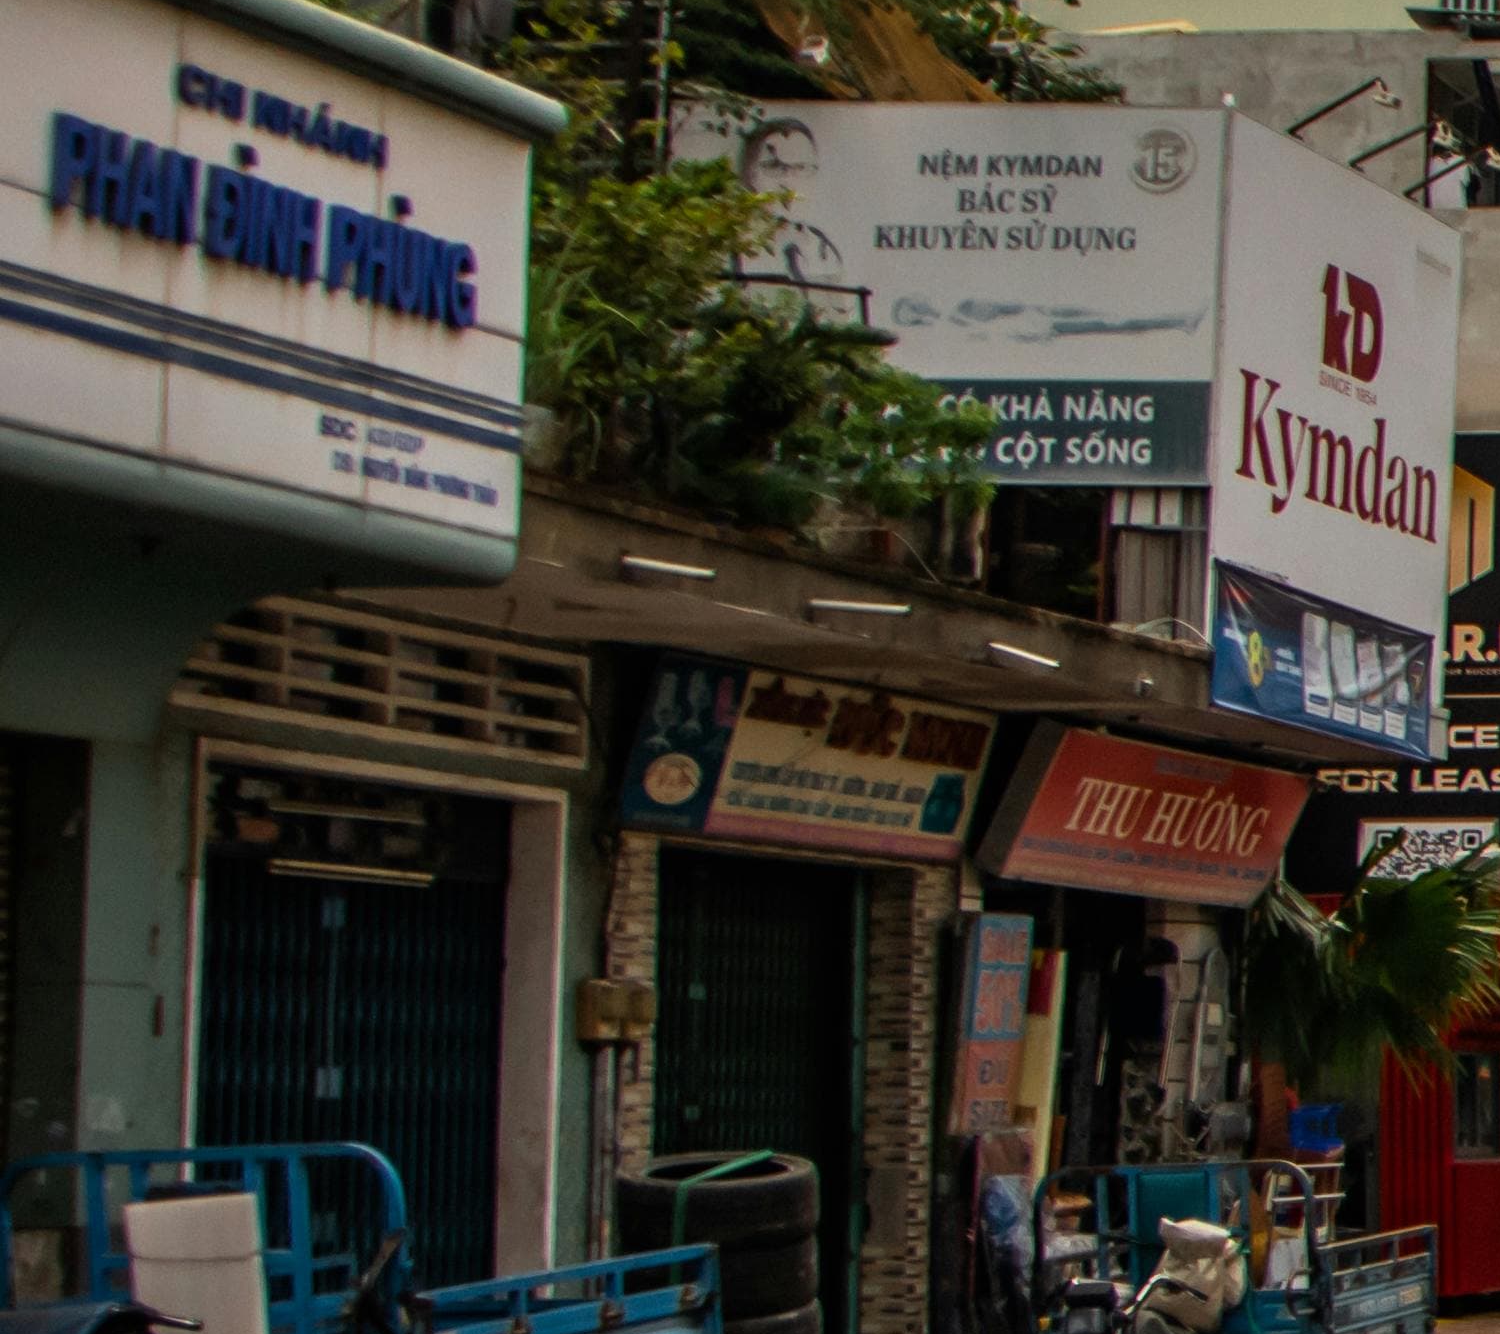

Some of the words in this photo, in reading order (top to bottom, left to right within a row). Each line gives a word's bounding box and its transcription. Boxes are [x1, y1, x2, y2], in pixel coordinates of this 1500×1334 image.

[178, 63, 246, 123] CHI
[253, 91, 390, 171] NHÁNH
[49, 110, 198, 245] PHAN
[919, 148, 978, 181] NỆM
[985, 154, 1103, 176] KYMDAN
[956, 182, 1015, 213] BÁC
[874, 218, 998, 250] KHUYÊN
[1050, 226, 1136, 256] DỤNG
[1319, 369, 1353, 397] SINCE
[1063, 388, 1154, 422] NĂNG
[995, 430, 1056, 468] CỘT
[1064, 428, 1152, 465] SỐNG
[1236, 368, 1438, 544] Kymdan
[1448, 725, 1500, 749] CE
[1318, 770, 1399, 794] FOR
[1064, 776, 1152, 840] THU
